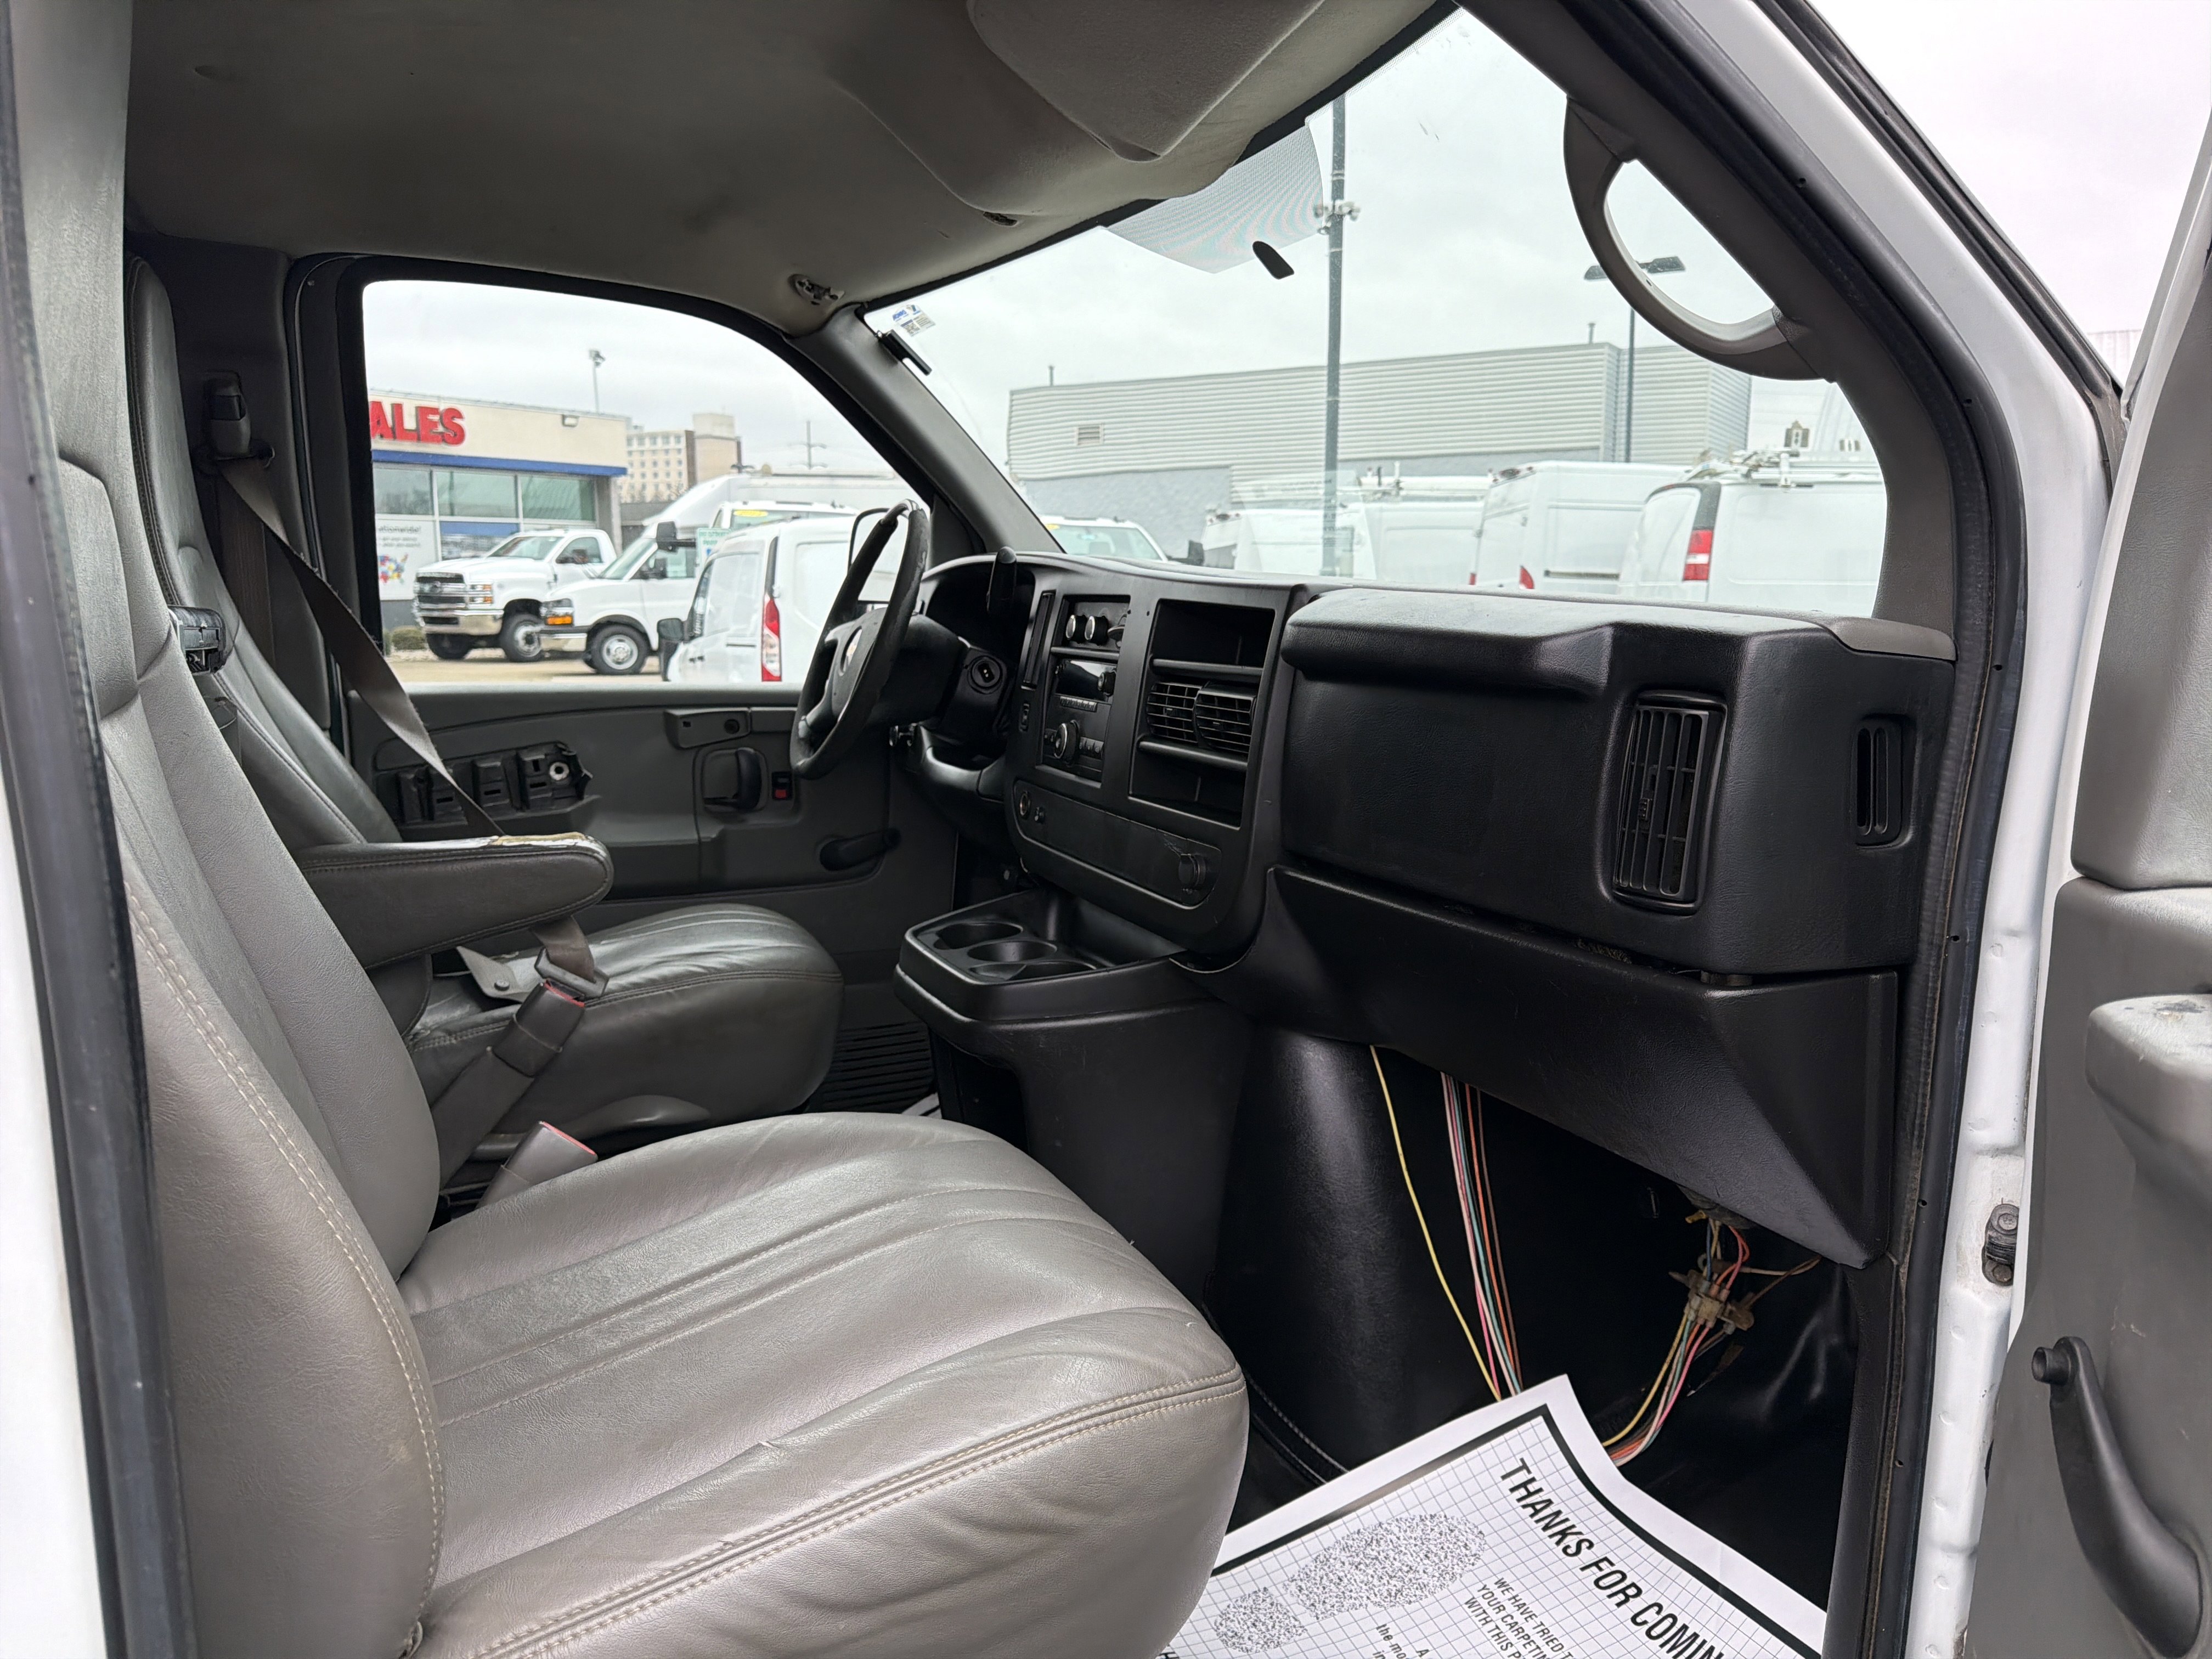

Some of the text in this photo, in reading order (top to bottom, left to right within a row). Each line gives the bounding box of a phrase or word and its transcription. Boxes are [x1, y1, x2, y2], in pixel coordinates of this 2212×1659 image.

[370, 401, 465, 445] ALES
[1500, 1457, 1595, 1558] THANKS
[1580, 1556, 1643, 1608] FOR
[1477, 1584, 1506, 1614] YOUR
[1494, 1577, 1515, 1595] WE
[1508, 1594, 1538, 1623] HAVE
[1532, 1621, 1565, 1652] TRIED
[1375, 1623, 1410, 1659] the mo
[1464, 1597, 1493, 1626] WITH
[1487, 1625, 1514, 1651] THIS
